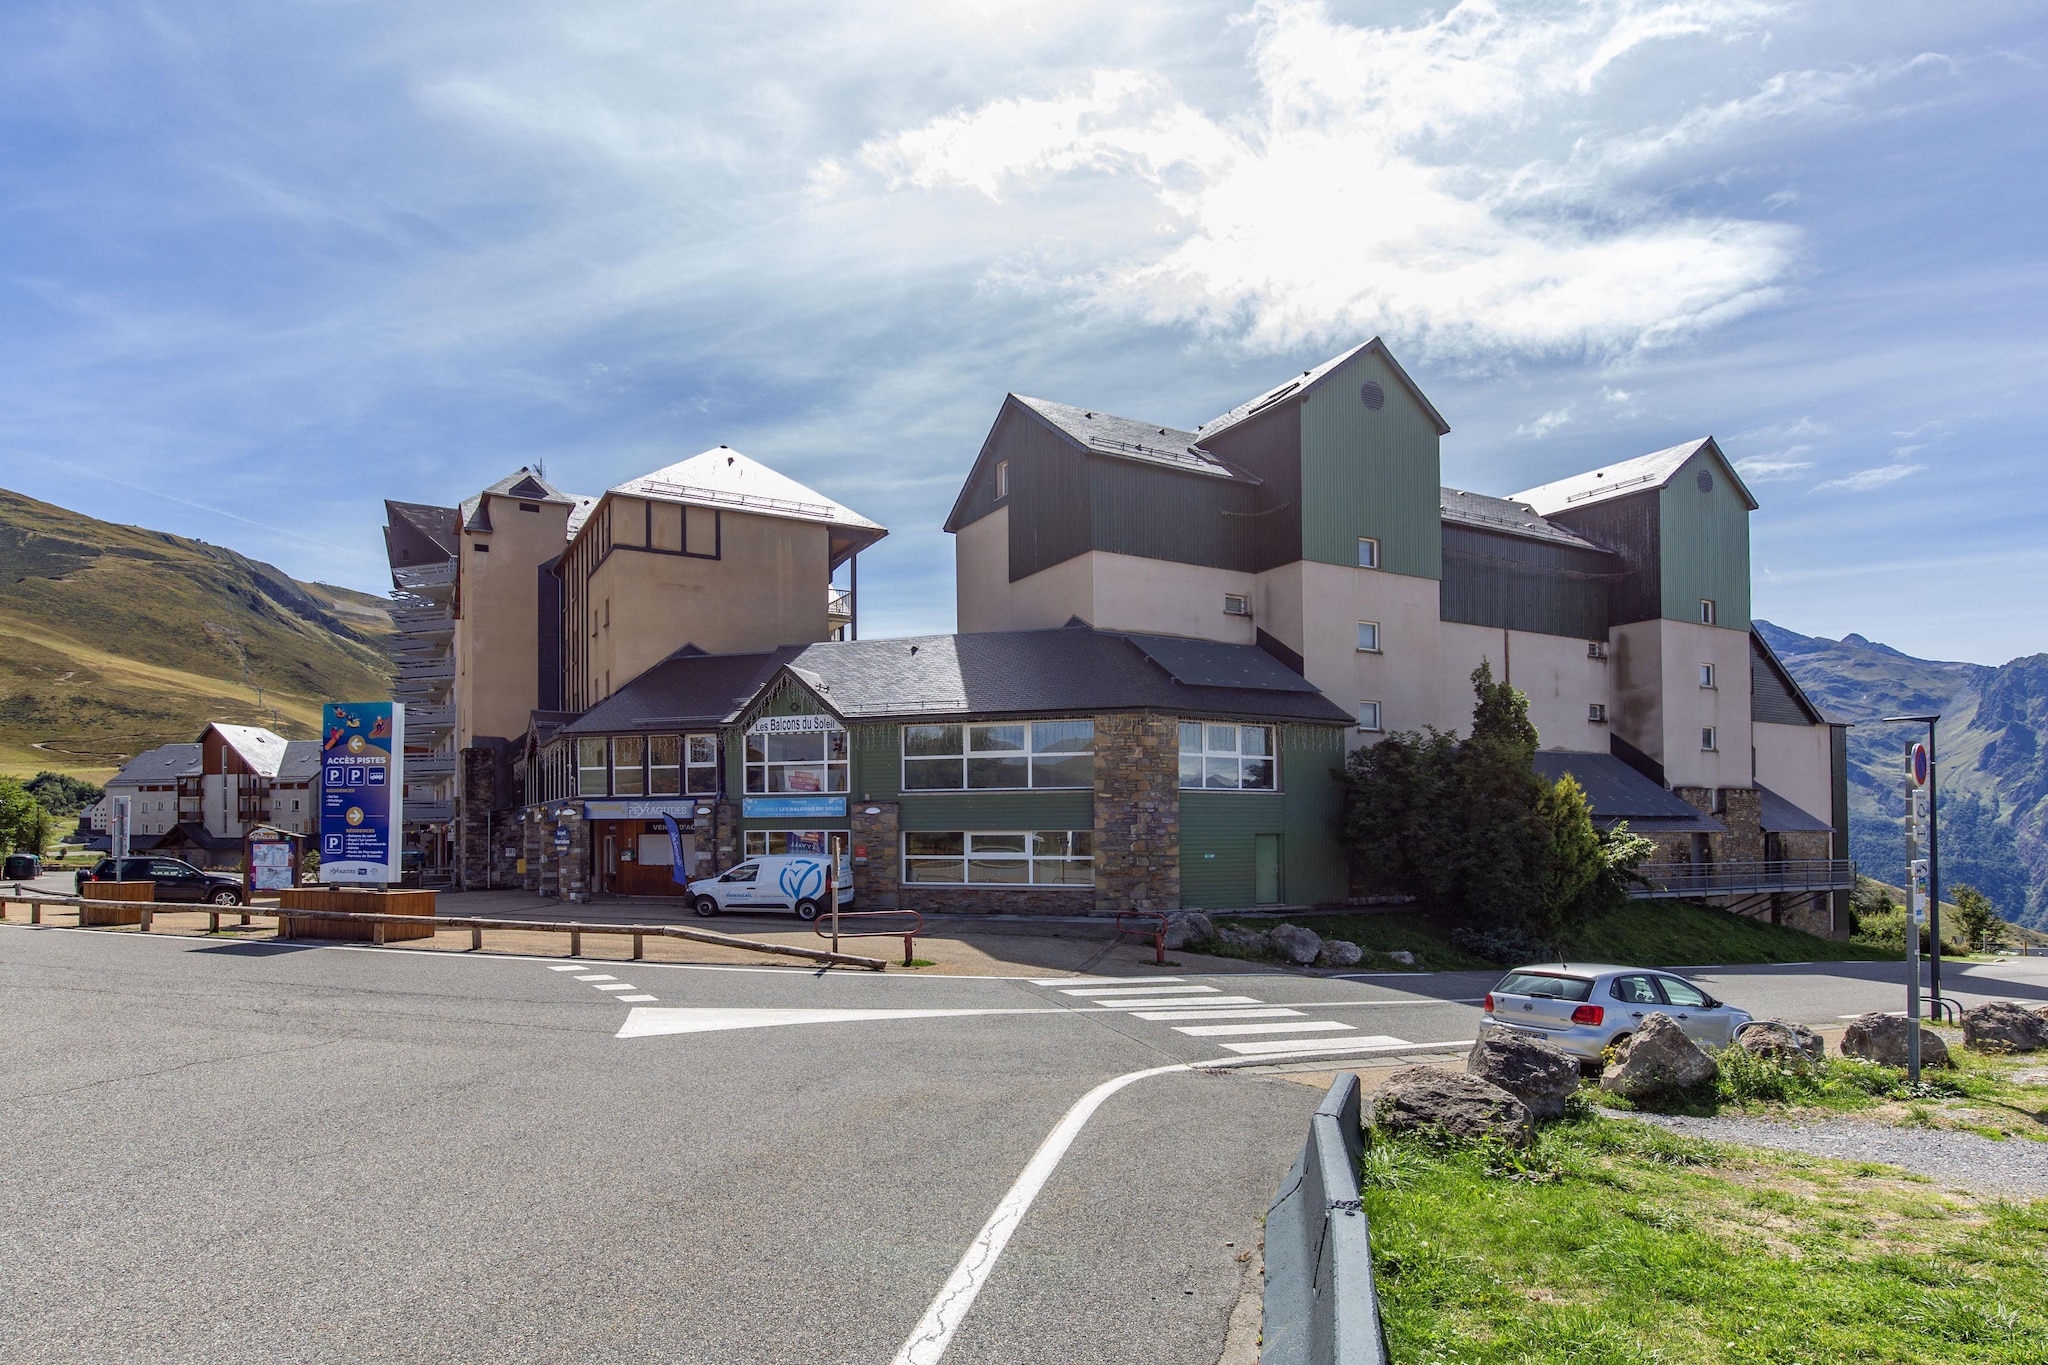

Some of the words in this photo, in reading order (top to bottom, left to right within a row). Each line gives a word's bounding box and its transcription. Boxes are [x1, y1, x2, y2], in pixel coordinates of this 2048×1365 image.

[755, 723, 769, 732] Les
[770, 718, 800, 731] Balcons
[802, 716, 812, 729] du
[813, 716, 835, 729] Soleil
[327, 755, 355, 764] ACCÈS
[356, 756, 387, 764] PISTES
[628, 802, 687, 817] PEYRAGUDES
